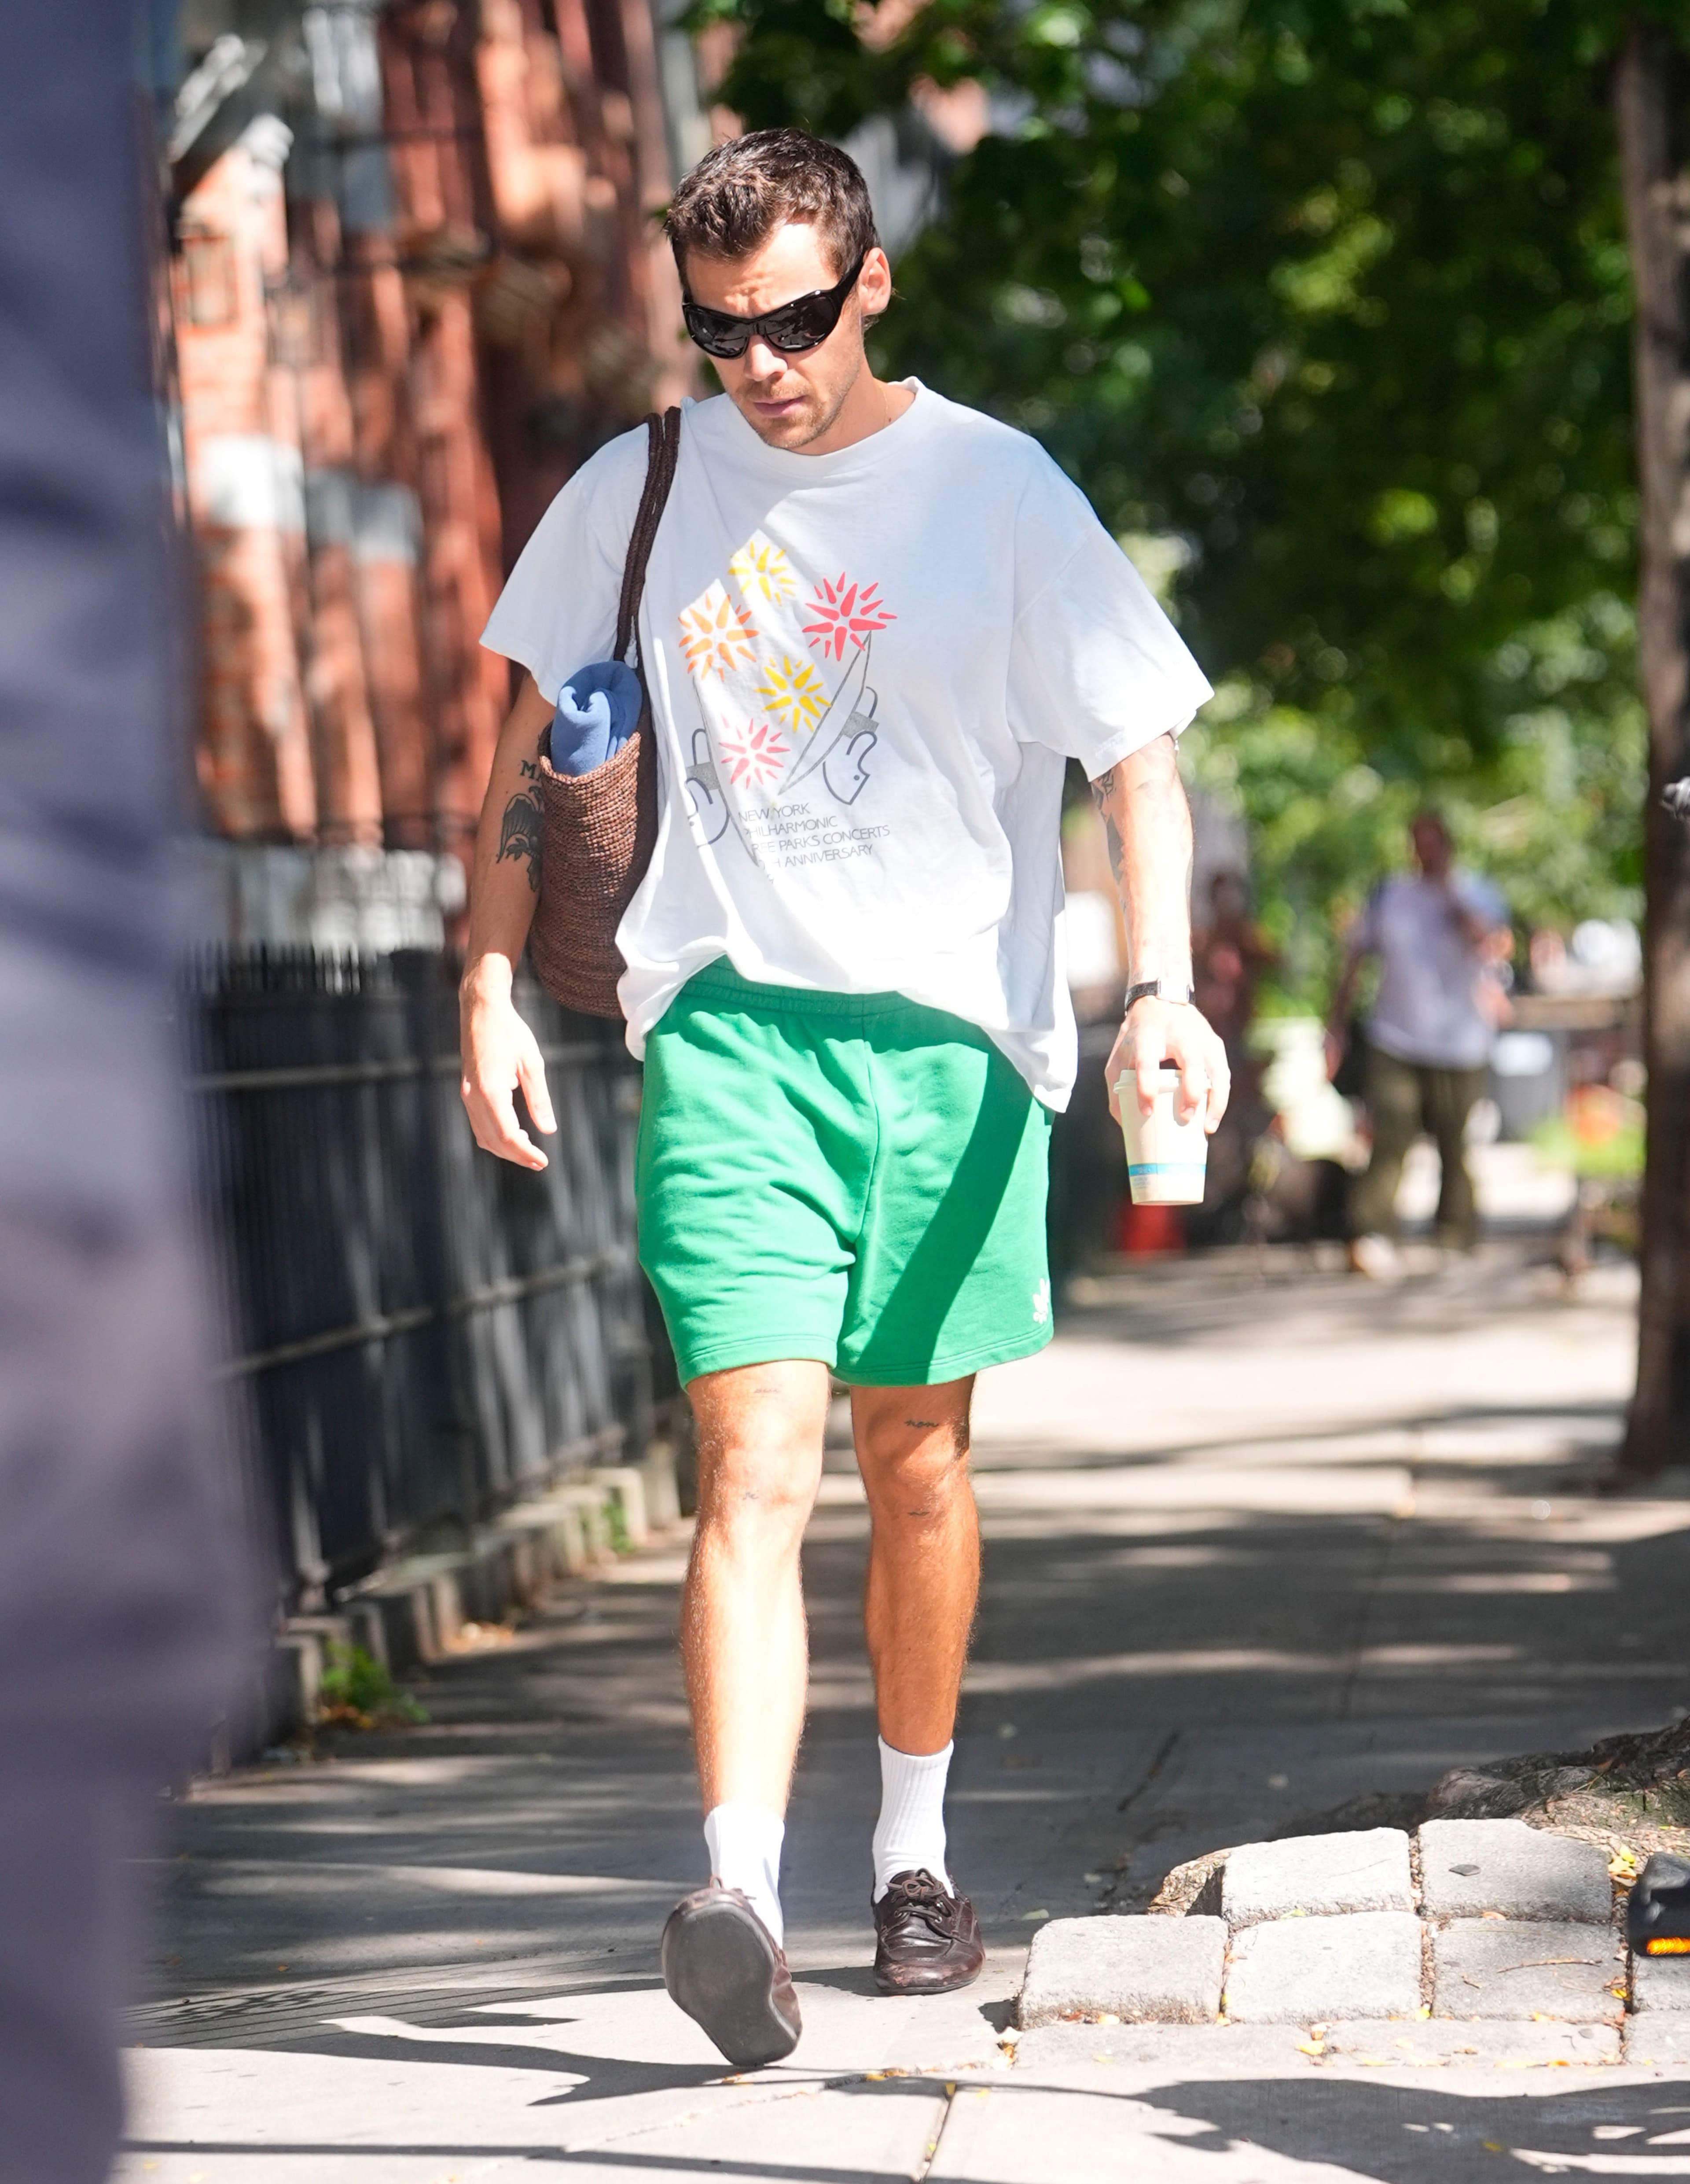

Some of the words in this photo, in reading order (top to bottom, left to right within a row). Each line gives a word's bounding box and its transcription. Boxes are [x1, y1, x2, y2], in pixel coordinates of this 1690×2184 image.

[738, 807, 770, 822] NEW
[773, 802, 810, 818] YORK
[779, 835, 820, 851] PARKS
[823, 825, 890, 845] CONCERTS
[785, 843, 873, 868] ANNIVERSARY
